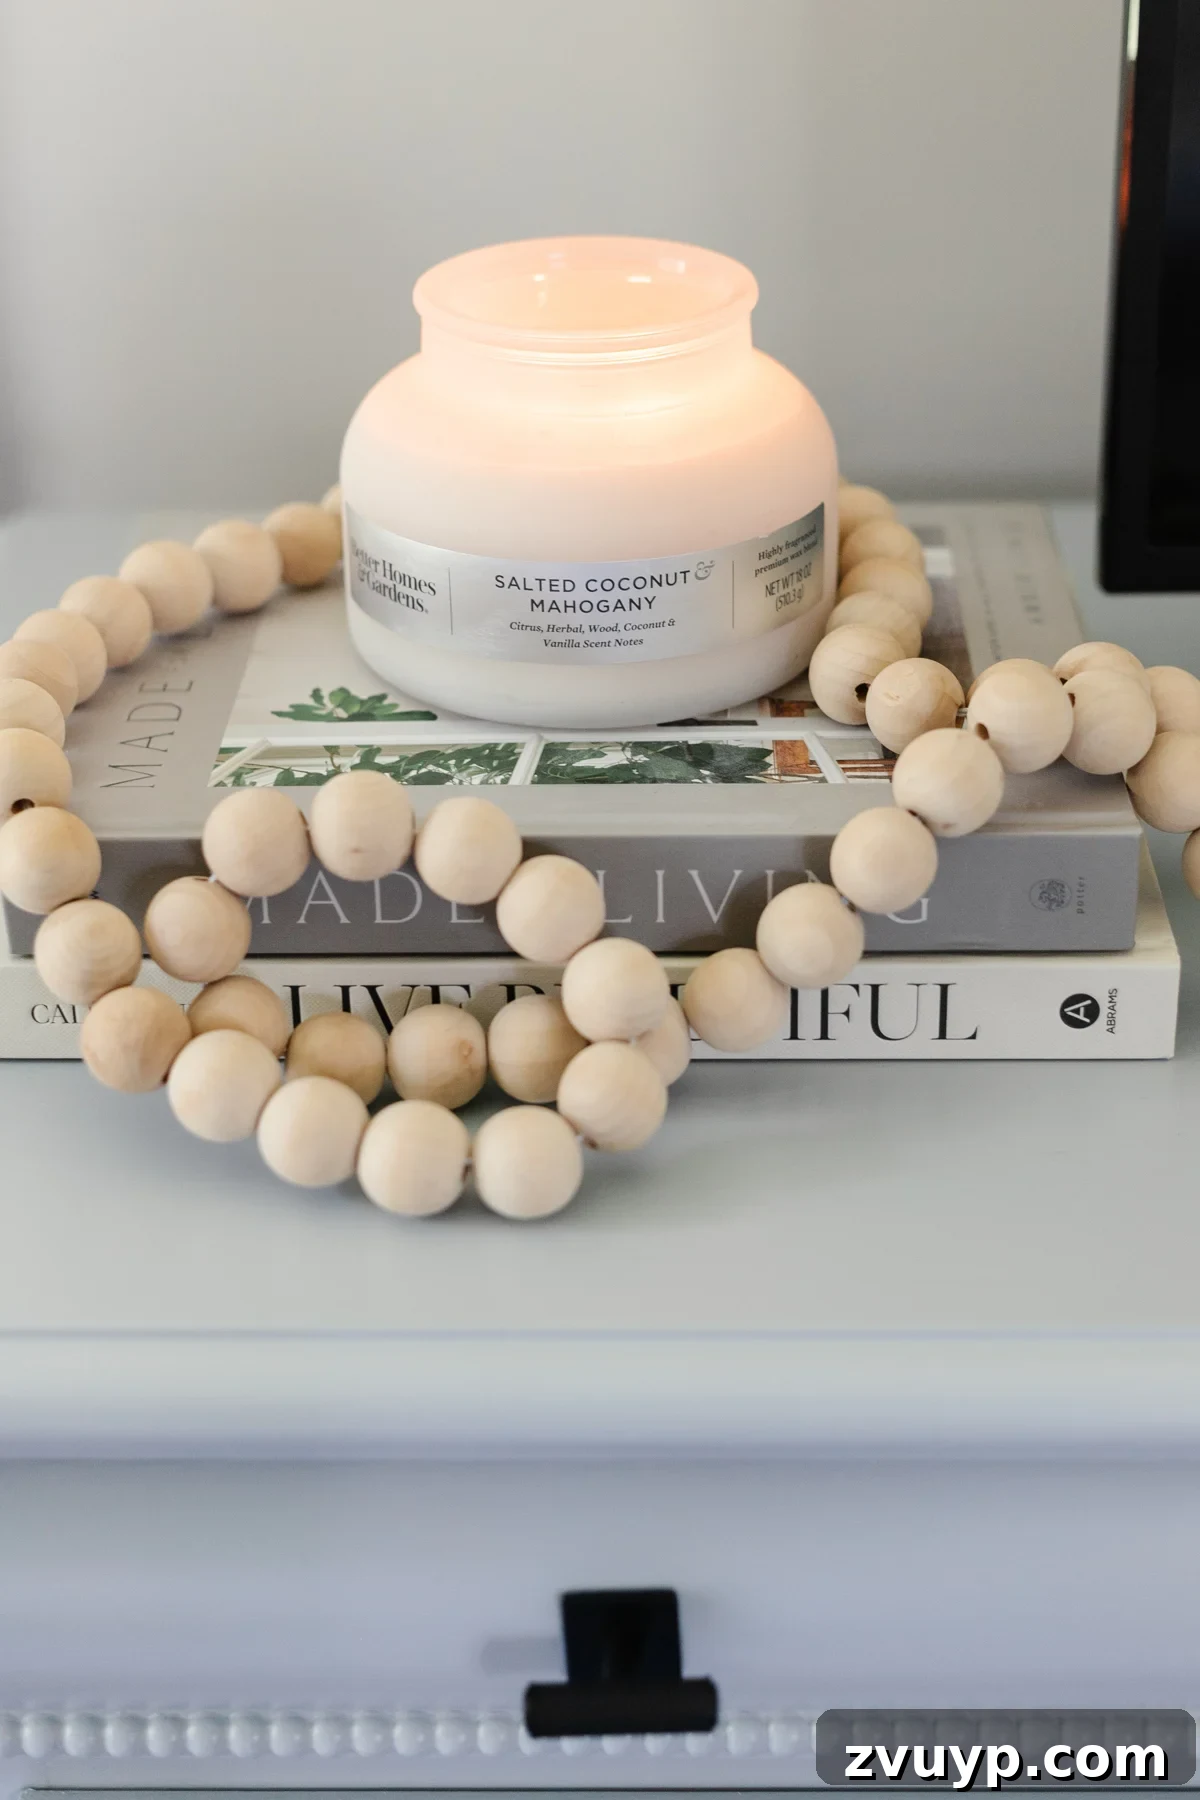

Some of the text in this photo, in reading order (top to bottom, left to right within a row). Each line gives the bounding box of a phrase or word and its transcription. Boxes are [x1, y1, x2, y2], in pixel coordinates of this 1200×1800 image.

[758, 544, 783, 561] Highly
[381, 559, 437, 597] Homes
[495, 559, 716, 593] SALTED COCONUT &
[754, 557, 789, 578] premium
[765, 579, 781, 598] NET
[781, 571, 795, 591] WT
[530, 595, 657, 614] MAHOGANY
[509, 618, 676, 634] Citrus, Herbal, Wood, Coconut &
[543, 637, 644, 649] Vanilla Scent Notes
[99, 679, 194, 789] MADE
[1075, 876, 1087, 914] potter
[1105, 987, 1118, 1035] ABRAMS
